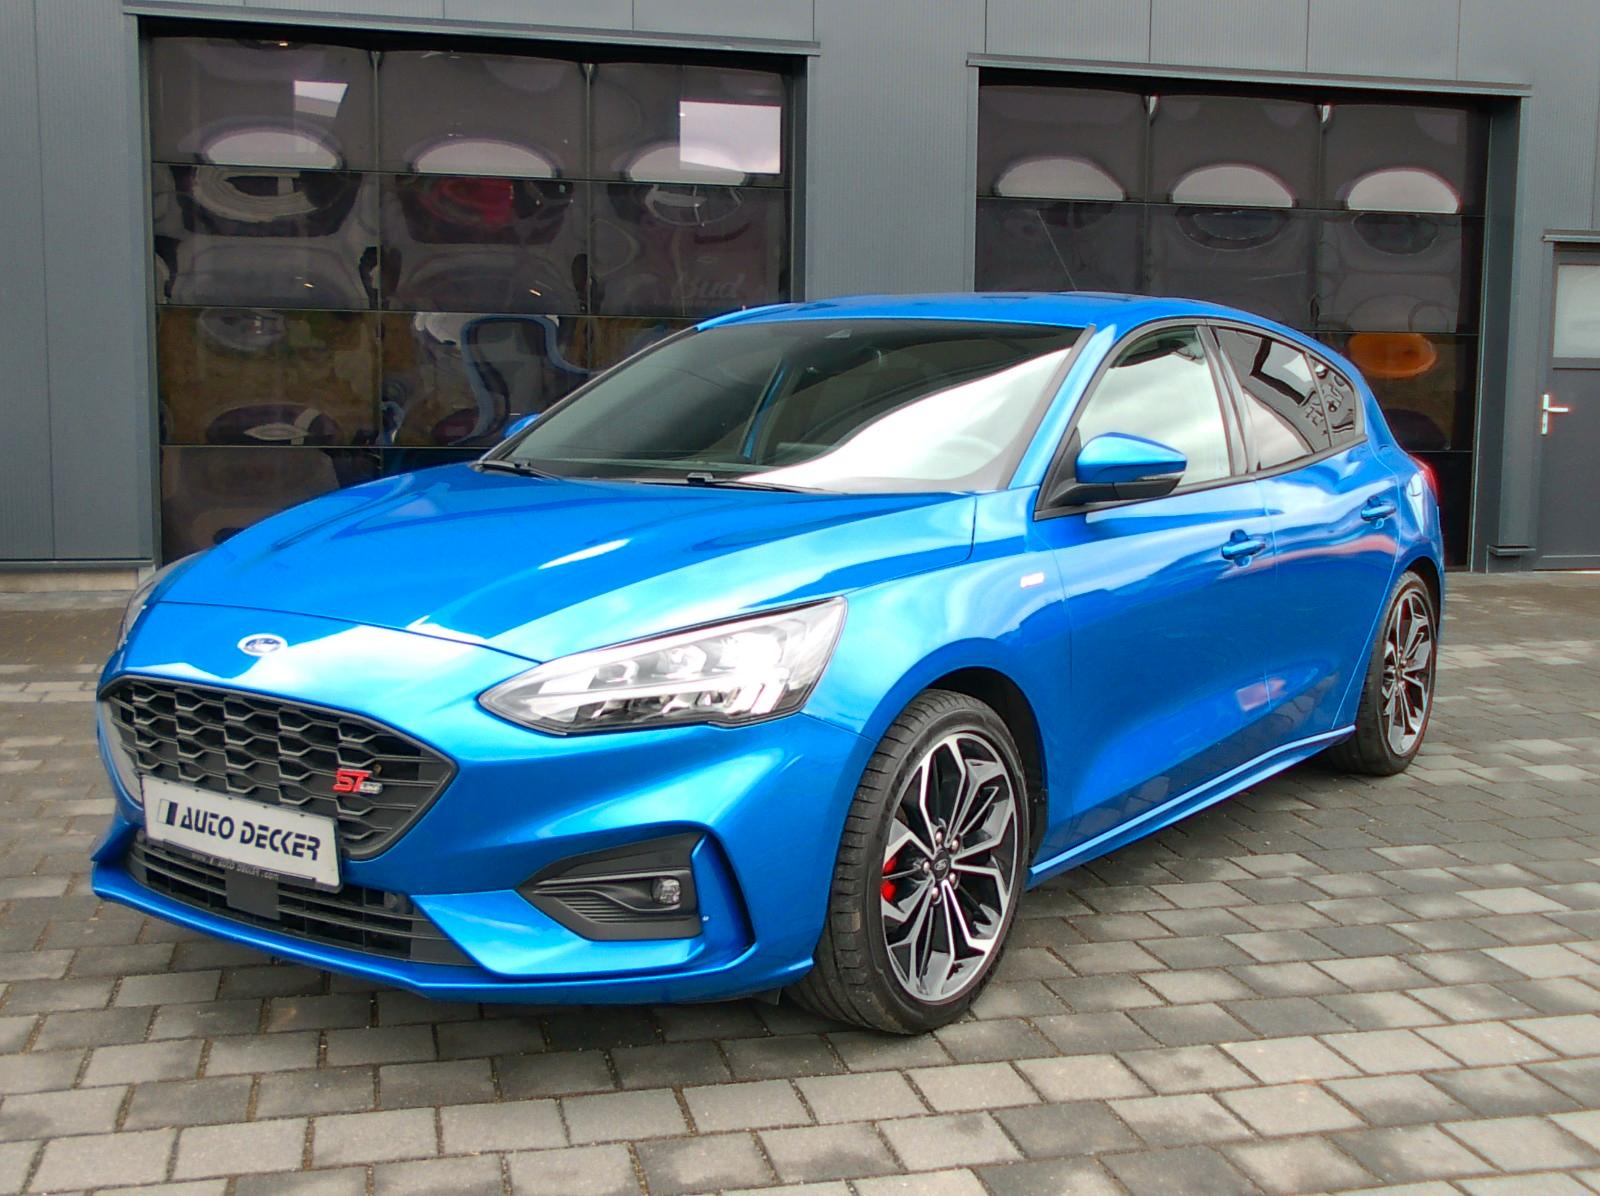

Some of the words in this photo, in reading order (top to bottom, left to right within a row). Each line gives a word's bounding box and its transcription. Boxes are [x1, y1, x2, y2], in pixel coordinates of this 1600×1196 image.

[333, 768, 372, 793] ST
[180, 807, 234, 839] AUTO
[240, 821, 320, 861] DECKER
